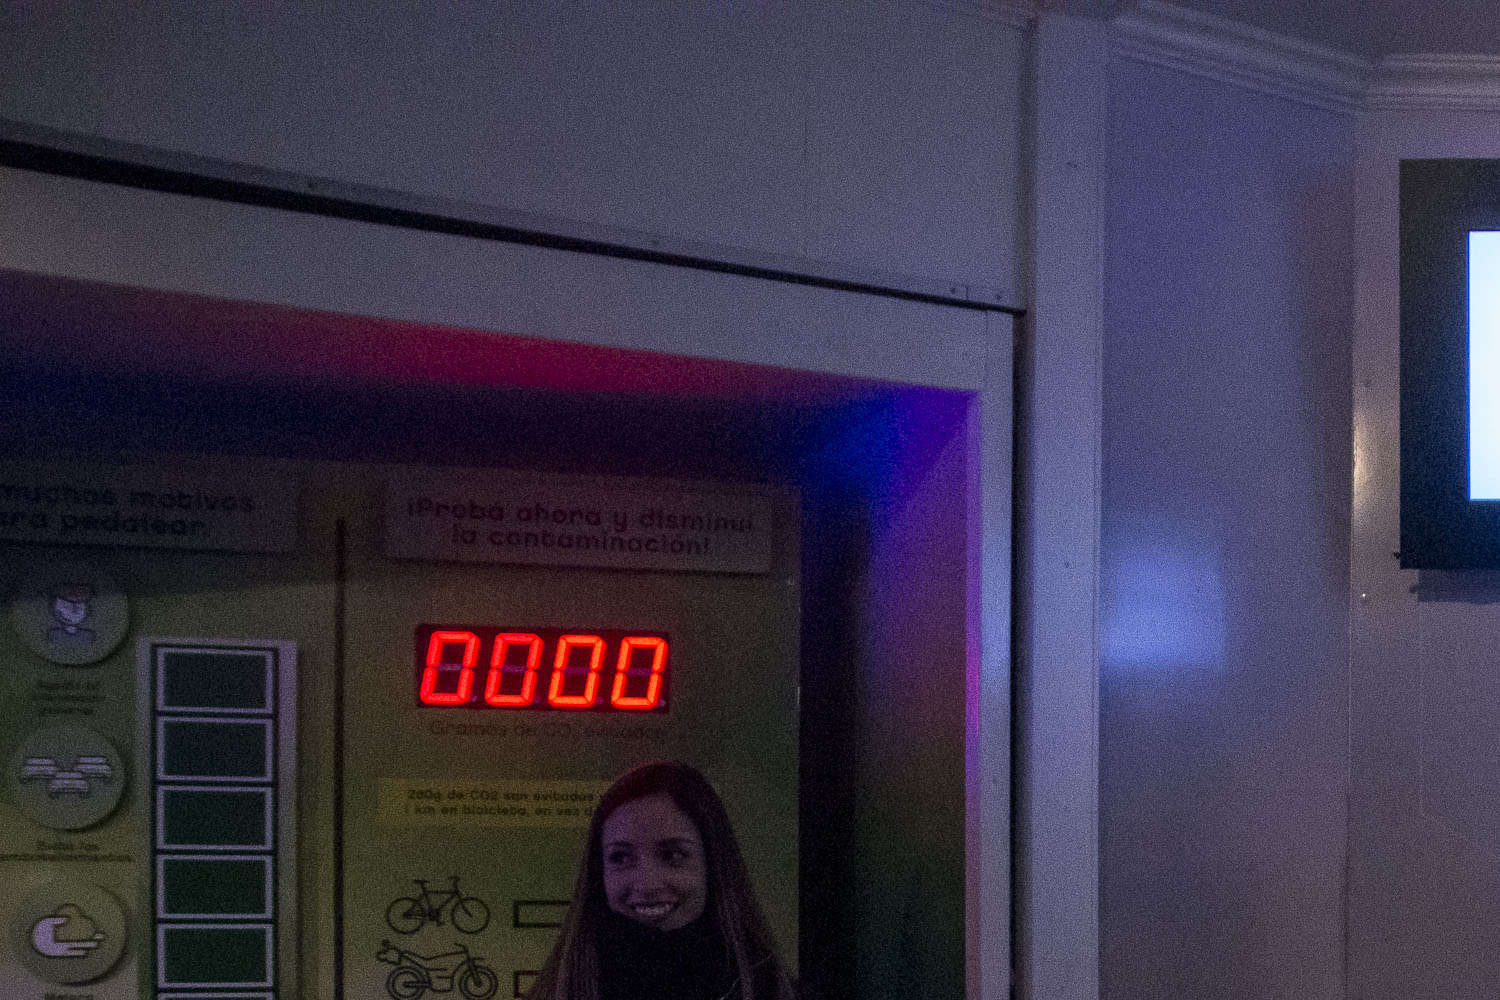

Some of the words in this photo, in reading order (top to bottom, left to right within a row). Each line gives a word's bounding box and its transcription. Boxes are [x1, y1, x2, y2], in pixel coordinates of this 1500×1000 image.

[130, 490, 256, 513] motivos
[516, 502, 601, 527] ahora
[612, 511, 628, 533] y
[420, 630, 668, 709] 0000
